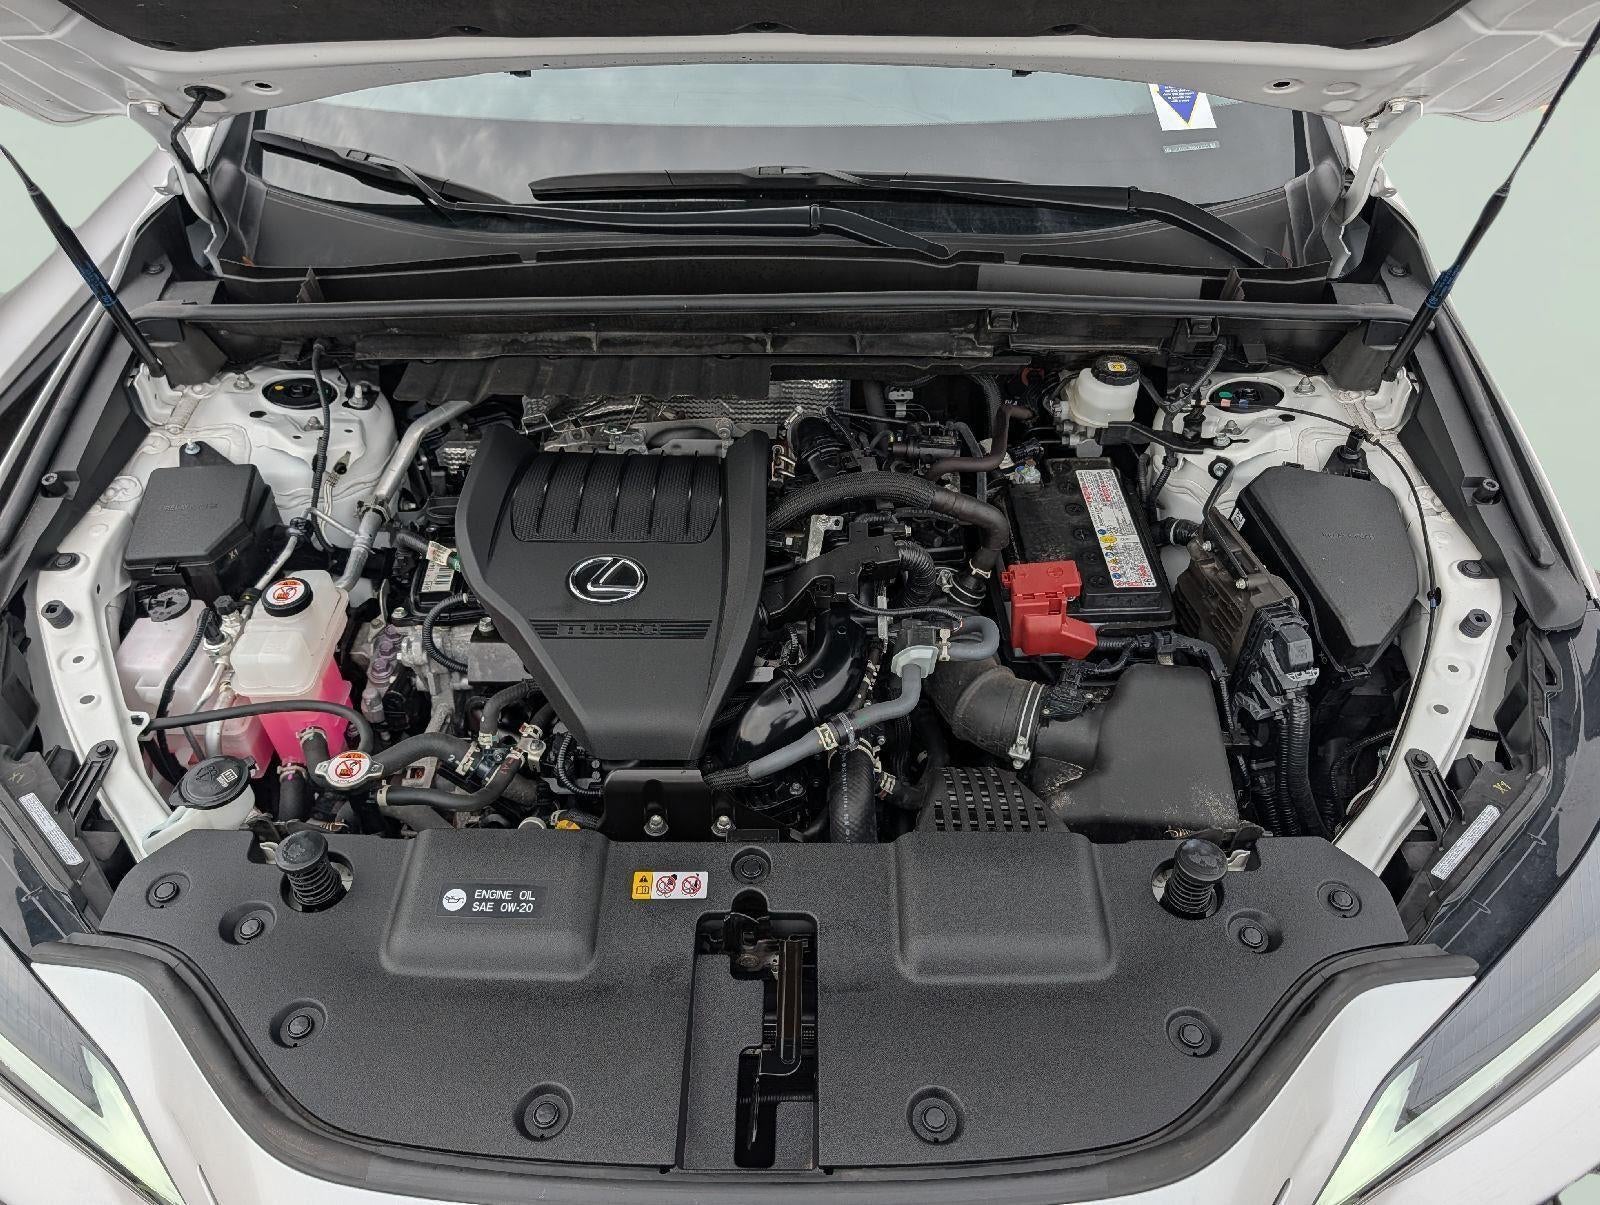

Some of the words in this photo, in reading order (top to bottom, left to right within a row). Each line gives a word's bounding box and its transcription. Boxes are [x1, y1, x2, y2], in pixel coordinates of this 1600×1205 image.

[558, 622, 660, 637] TURBO
[474, 889, 514, 900] ENGINE
[519, 890, 536, 901] OIL
[472, 901, 494, 912] SAE
